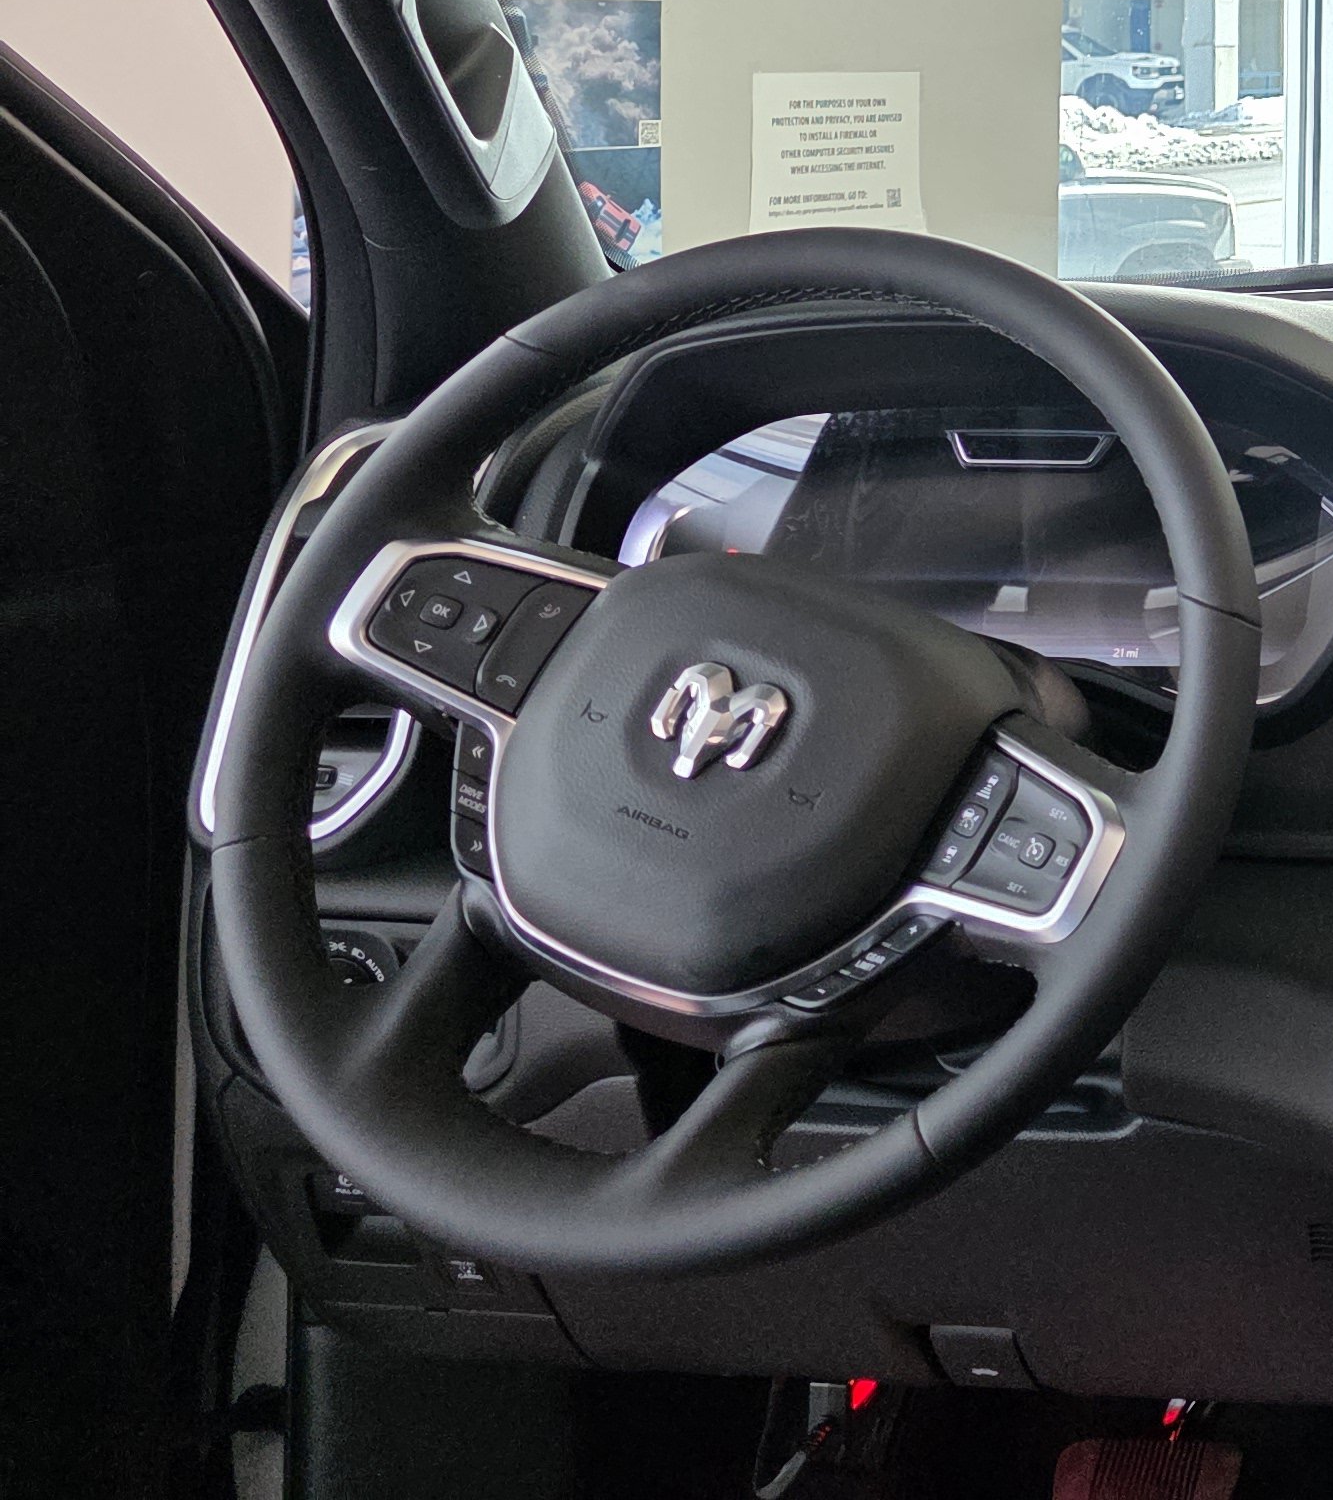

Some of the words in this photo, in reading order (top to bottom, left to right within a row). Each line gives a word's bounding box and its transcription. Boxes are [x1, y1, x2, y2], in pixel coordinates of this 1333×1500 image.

[789, 100, 802, 110] FOR
[803, 99, 814, 109] THE
[815, 99, 847, 109] PURPOSES
[847, 99, 855, 108] OF
[855, 98, 871, 108] YOUR
[872, 98, 887, 107] OWN
[771, 115, 810, 127] PROTECTION
[811, 115, 824, 125] AND
[825, 115, 853, 125] PRIVACY,
[853, 114, 865, 124] YOU
[865, 114, 877, 123] ARE
[877, 113, 902, 122] ADVISED
[799, 132, 807, 142] TO
[808, 131, 833, 141] INSTALL
[833, 132, 839, 140] A
[839, 130, 869, 140] FIREWALL
[869, 129, 877, 138] OR
[780, 149, 802, 159] OTHER
[802, 147, 835, 158] COMPUTER
[836, 146, 864, 156] SECURITY
[865, 144, 895, 154] MEASURES
[790, 164, 809, 175] WHEN
[810, 162, 843, 174] ACCESSING
[844, 162, 855, 171] THE
[856, 160, 886, 171] INTERNET.
[432, 603, 452, 619] OK
[1112, 647, 1125, 659] 21
[1125, 648, 1139, 659] mi
[459, 783, 485, 801] DRIVE
[457, 795, 487, 814] MODES
[616, 805, 691, 840] AIRBAG
[997, 832, 1021, 849] CANC
[1055, 854, 1069, 867] RES
[365, 958, 385, 982] AUTO
